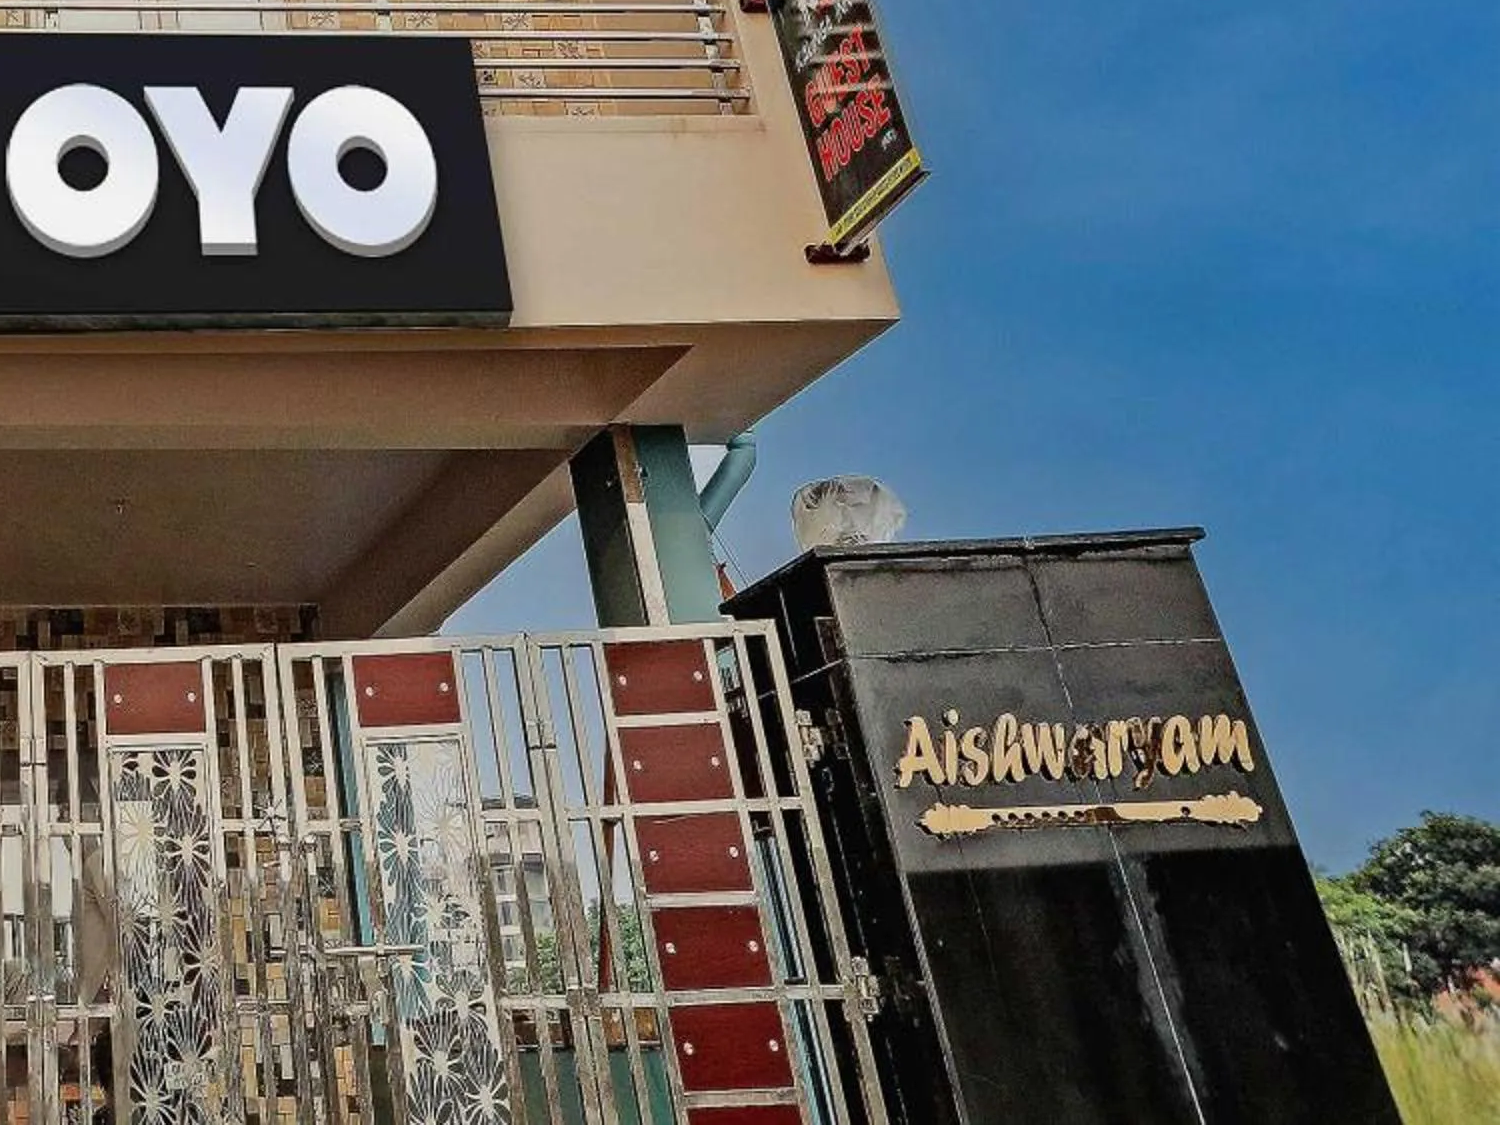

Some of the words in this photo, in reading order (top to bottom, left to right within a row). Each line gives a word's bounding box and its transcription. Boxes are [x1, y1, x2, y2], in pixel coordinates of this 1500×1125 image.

[806, 25, 870, 126] GUEST
[5, 82, 438, 258] OYO
[817, 76, 890, 181] HOUSE
[897, 707, 1255, 790] Aishwaryam
